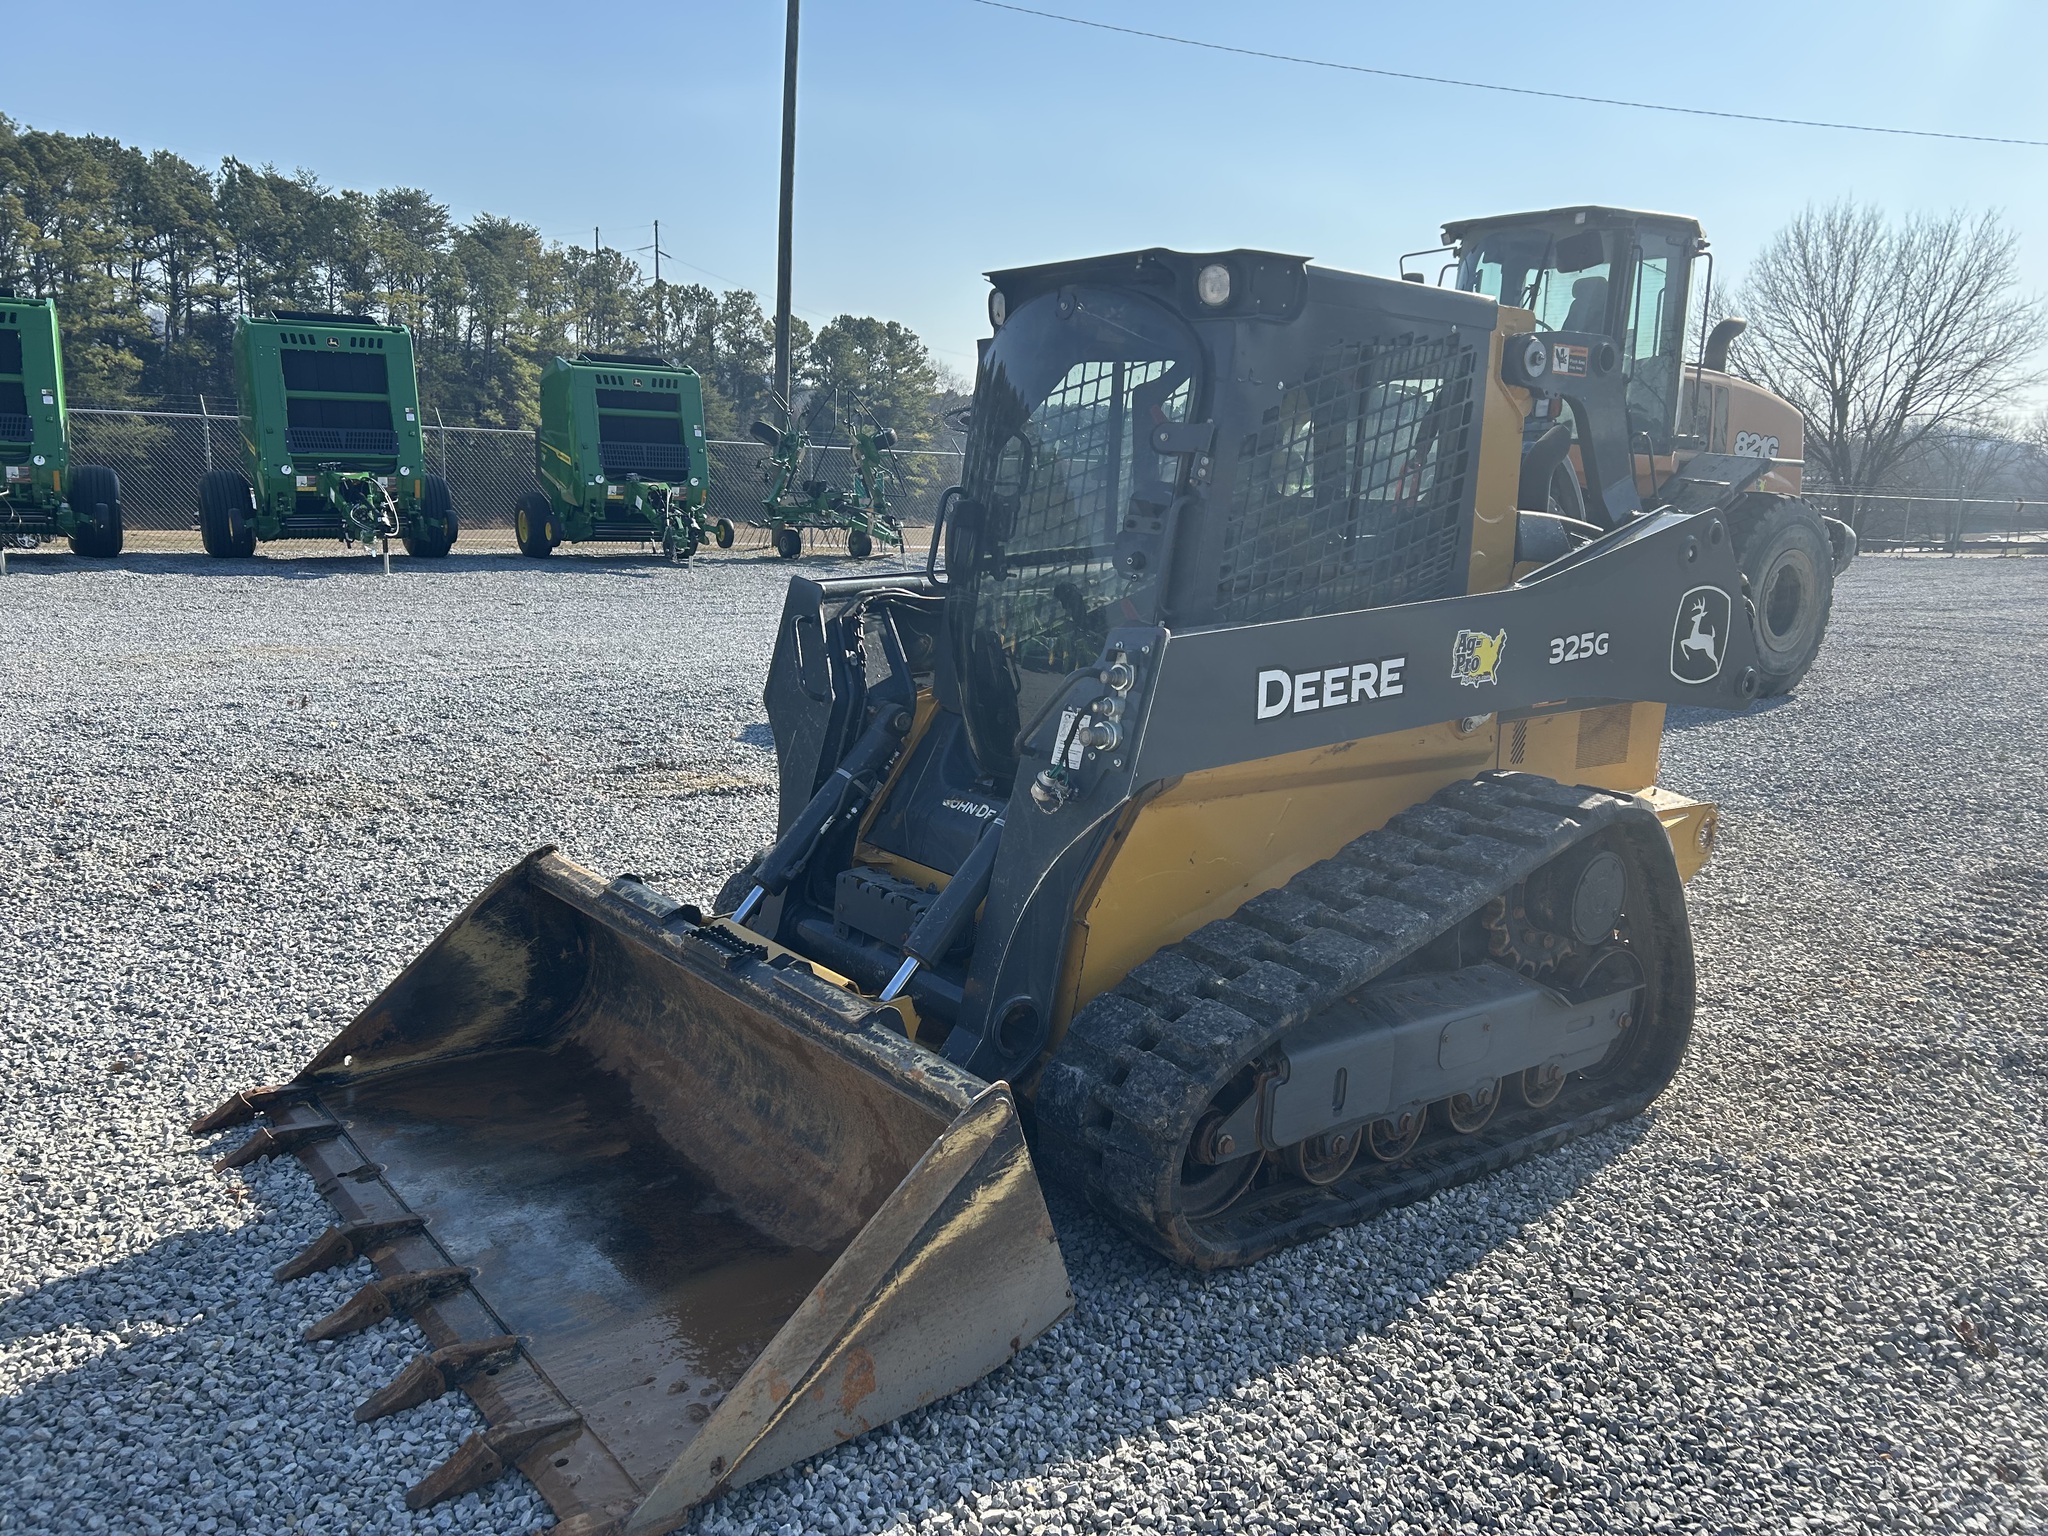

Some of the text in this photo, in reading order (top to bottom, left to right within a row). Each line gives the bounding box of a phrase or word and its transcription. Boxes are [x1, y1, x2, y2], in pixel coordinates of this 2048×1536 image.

[1734, 430, 1779, 458] 821G
[1549, 632, 1609, 664] 325G
[1454, 654, 1481, 676] Pro
[1257, 657, 1405, 719] DEERE
